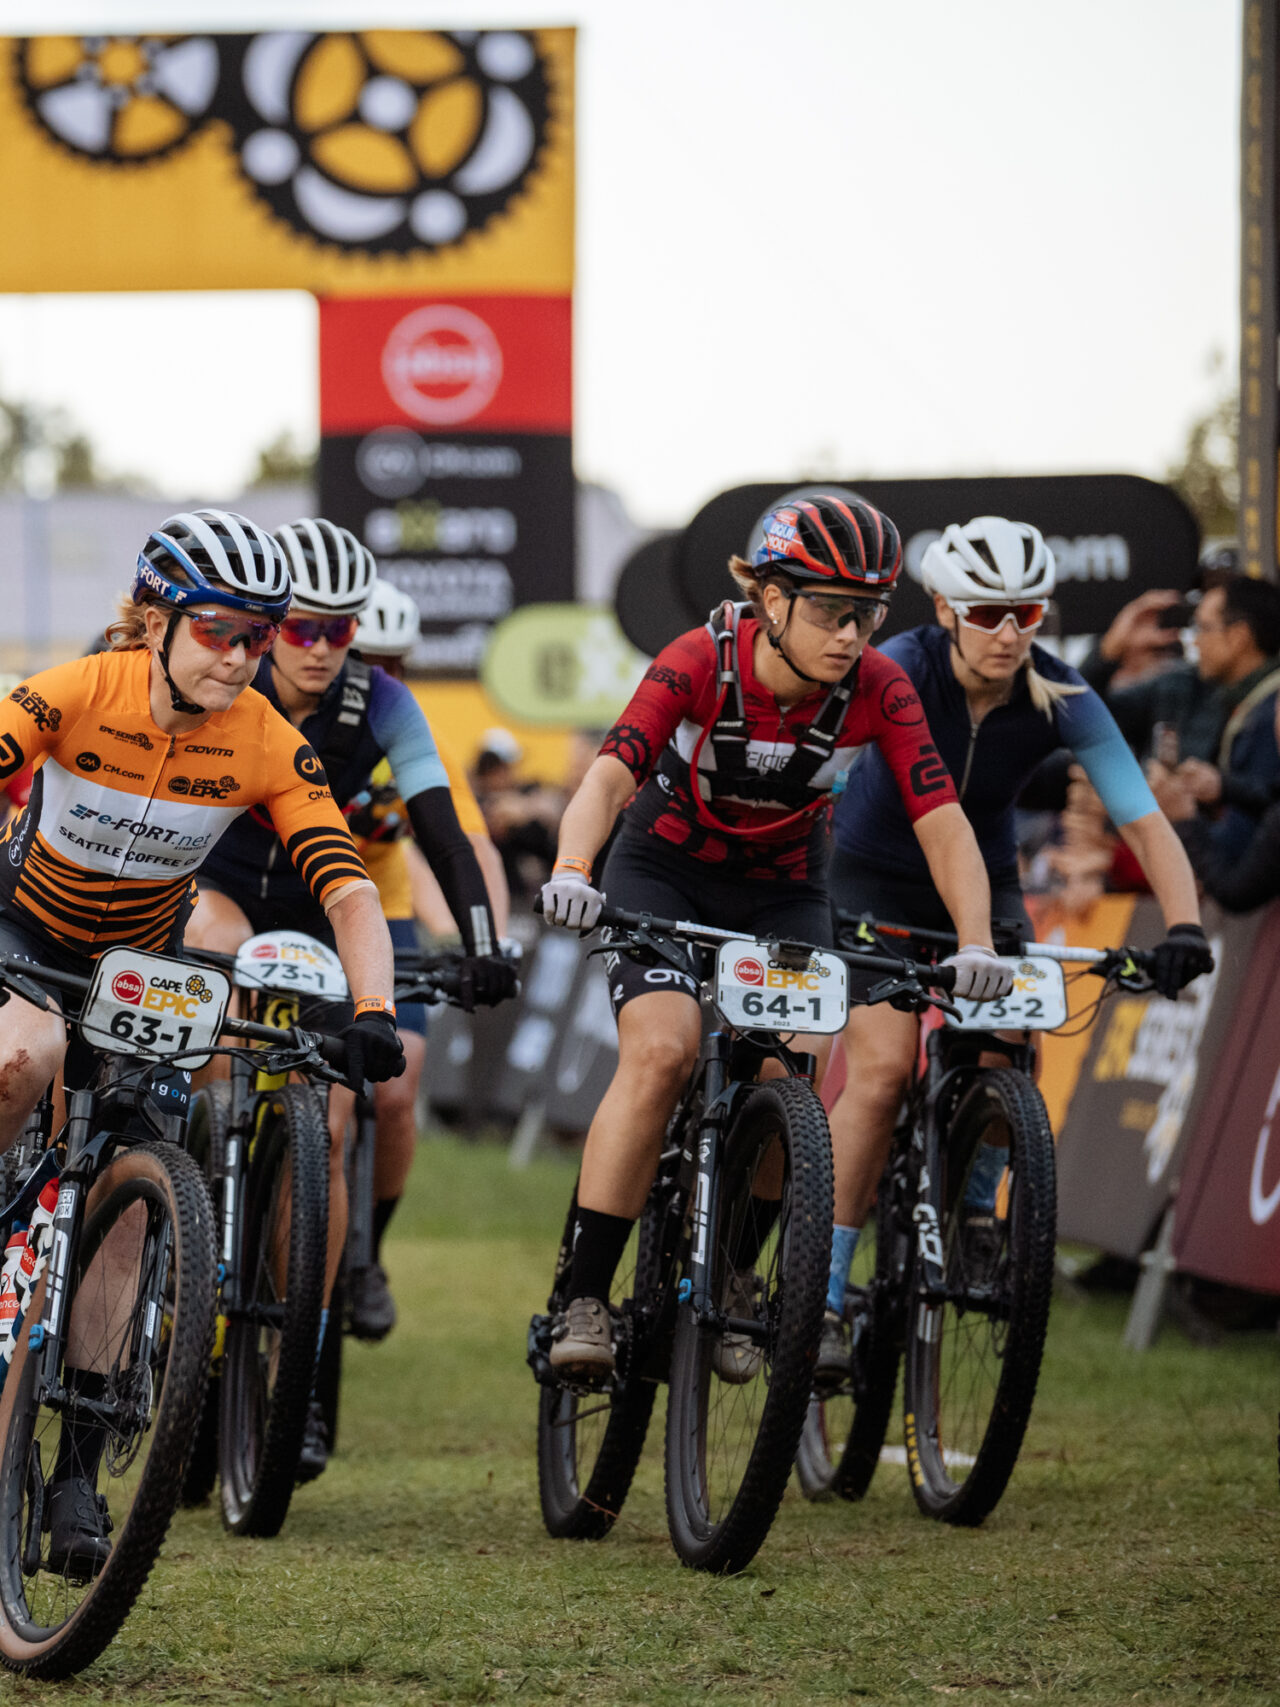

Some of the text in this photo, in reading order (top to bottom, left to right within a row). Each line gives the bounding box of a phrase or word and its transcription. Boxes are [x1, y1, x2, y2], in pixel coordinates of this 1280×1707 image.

[20, 696, 51, 732] EPIC
[103, 764, 145, 781] CM.com
[194, 778, 218, 786] CAPE
[190, 785, 231, 799] EPIC
[98, 814, 212, 847] e-FORT.net
[59, 826, 123, 858] SEATTLE
[125, 850, 180, 867] COFFEE
[260, 963, 326, 989] 73-1
[739, 964, 760, 976] absa
[767, 969, 819, 991] EPIC
[116, 980, 140, 992] absa
[150, 977, 182, 993] CAPE
[143, 987, 200, 1019] EPIC
[742, 992, 821, 1021] 64-1
[969, 998, 1044, 1018] 73-2
[110, 1010, 193, 1053] 63-1
